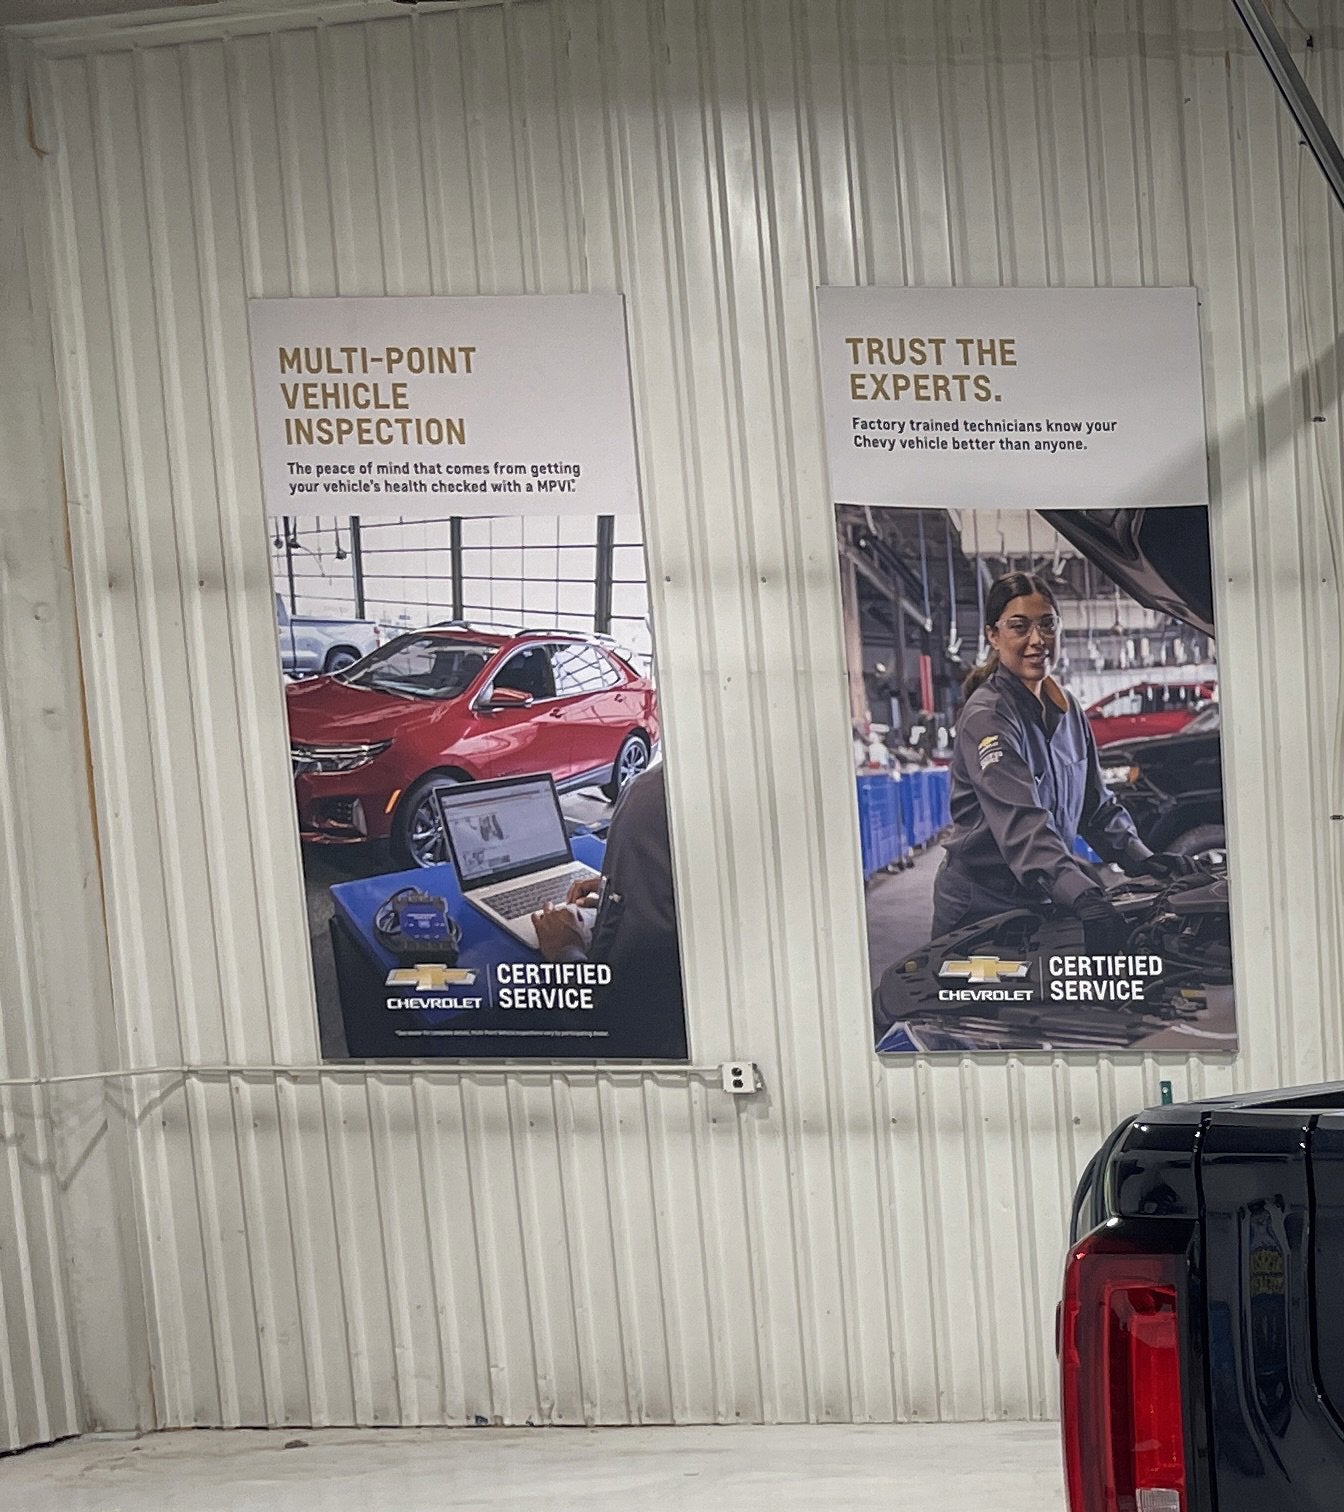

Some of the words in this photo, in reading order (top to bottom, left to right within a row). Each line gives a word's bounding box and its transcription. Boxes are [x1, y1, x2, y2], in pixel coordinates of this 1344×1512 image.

[278, 346, 477, 375] MULTI-POINT
[845, 337, 947, 366] TRUST
[955, 338, 1018, 367] THE
[280, 382, 410, 410] VEHICLE
[850, 373, 1003, 402] EXPERTS.
[284, 417, 467, 445] INSPECTION
[852, 417, 906, 434] Factory
[909, 418, 960, 432] trained
[963, 418, 1043, 433] technicians
[1046, 419, 1083, 432] know
[1086, 420, 1118, 435] your
[853, 435, 896, 452] Chevy
[900, 436, 948, 450] vehicle
[952, 437, 996, 450] better
[999, 437, 1031, 451] than
[1034, 439, 1088, 453] anyone.
[287, 461, 313, 475] The
[316, 463, 356, 478] peace
[359, 461, 374, 475] of
[376, 461, 410, 475] mind
[414, 461, 443, 475] that
[446, 462, 490, 476] comes
[493, 461, 527, 475] from
[530, 461, 581, 478] getting
[289, 481, 320, 496] your
[323, 479, 381, 493] vehicle's
[384, 479, 428, 493] health
[431, 479, 488, 493] checked
[490, 479, 522, 493] with
[525, 482, 534, 493] a
[496, 962, 612, 986] CERTIFIED
[1049, 954, 1163, 977] CERTIFIED
[498, 987, 594, 1010] SERVICE
[938, 989, 1034, 1001] CHEVROLET
[1050, 979, 1145, 1001] SERVICE
[386, 997, 483, 1010] CHEVROLET
